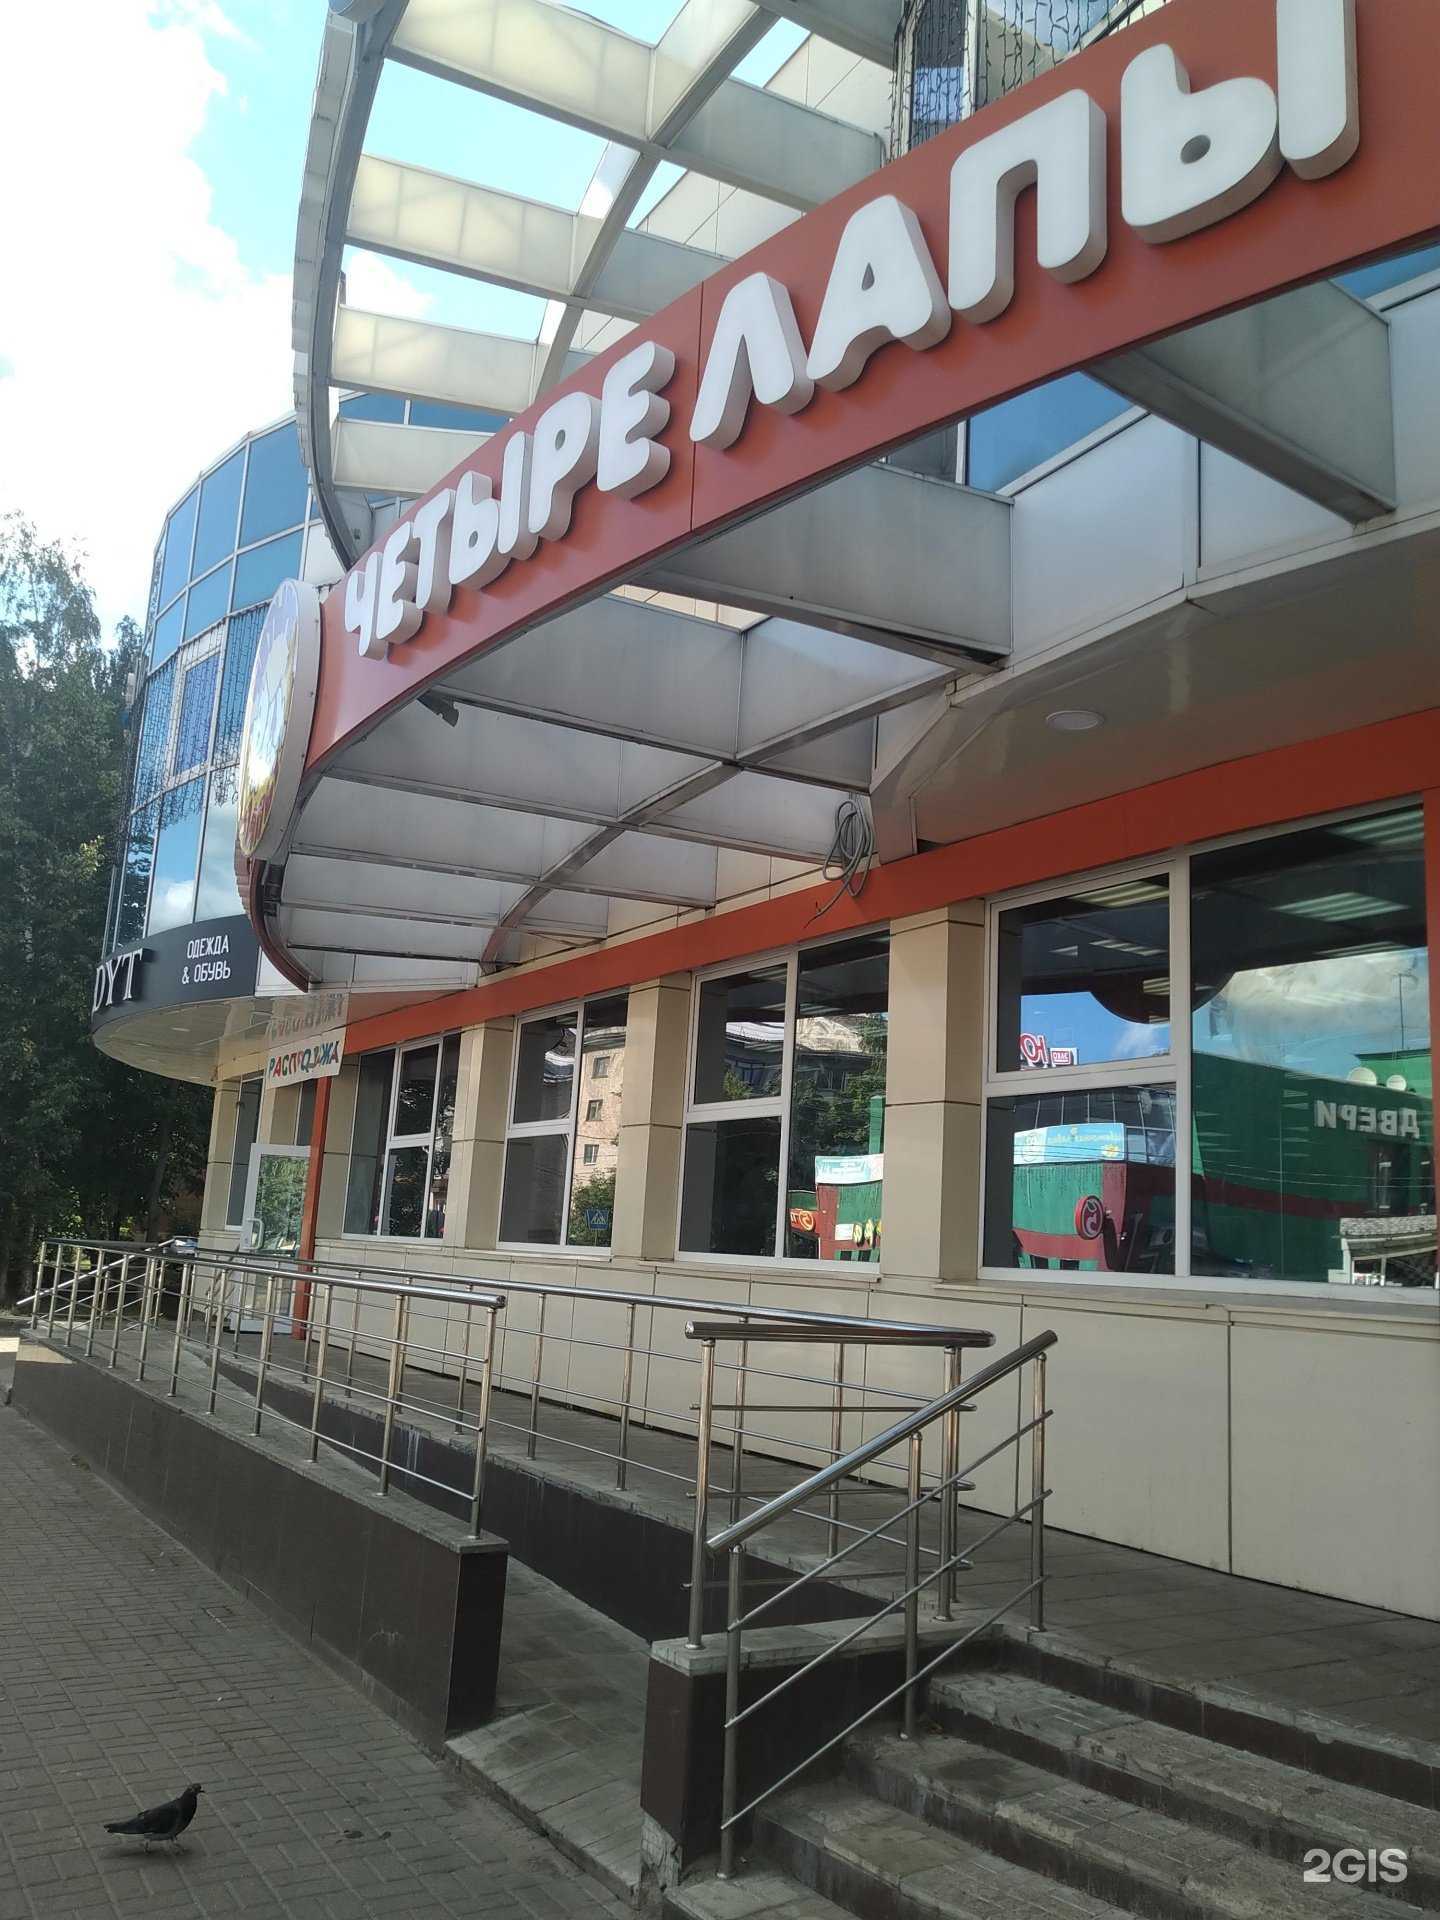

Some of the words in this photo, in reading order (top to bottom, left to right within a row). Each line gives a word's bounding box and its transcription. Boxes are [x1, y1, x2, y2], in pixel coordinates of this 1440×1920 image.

[344, 341, 675, 660] ЧЕТЫРЕ
[690, 0, 1360, 449] ЛАПЫ
[187, 935, 229, 959] ОДЕЖДА
[182, 966, 189, 984] &
[194, 960, 231, 982] ОБУВЬ
